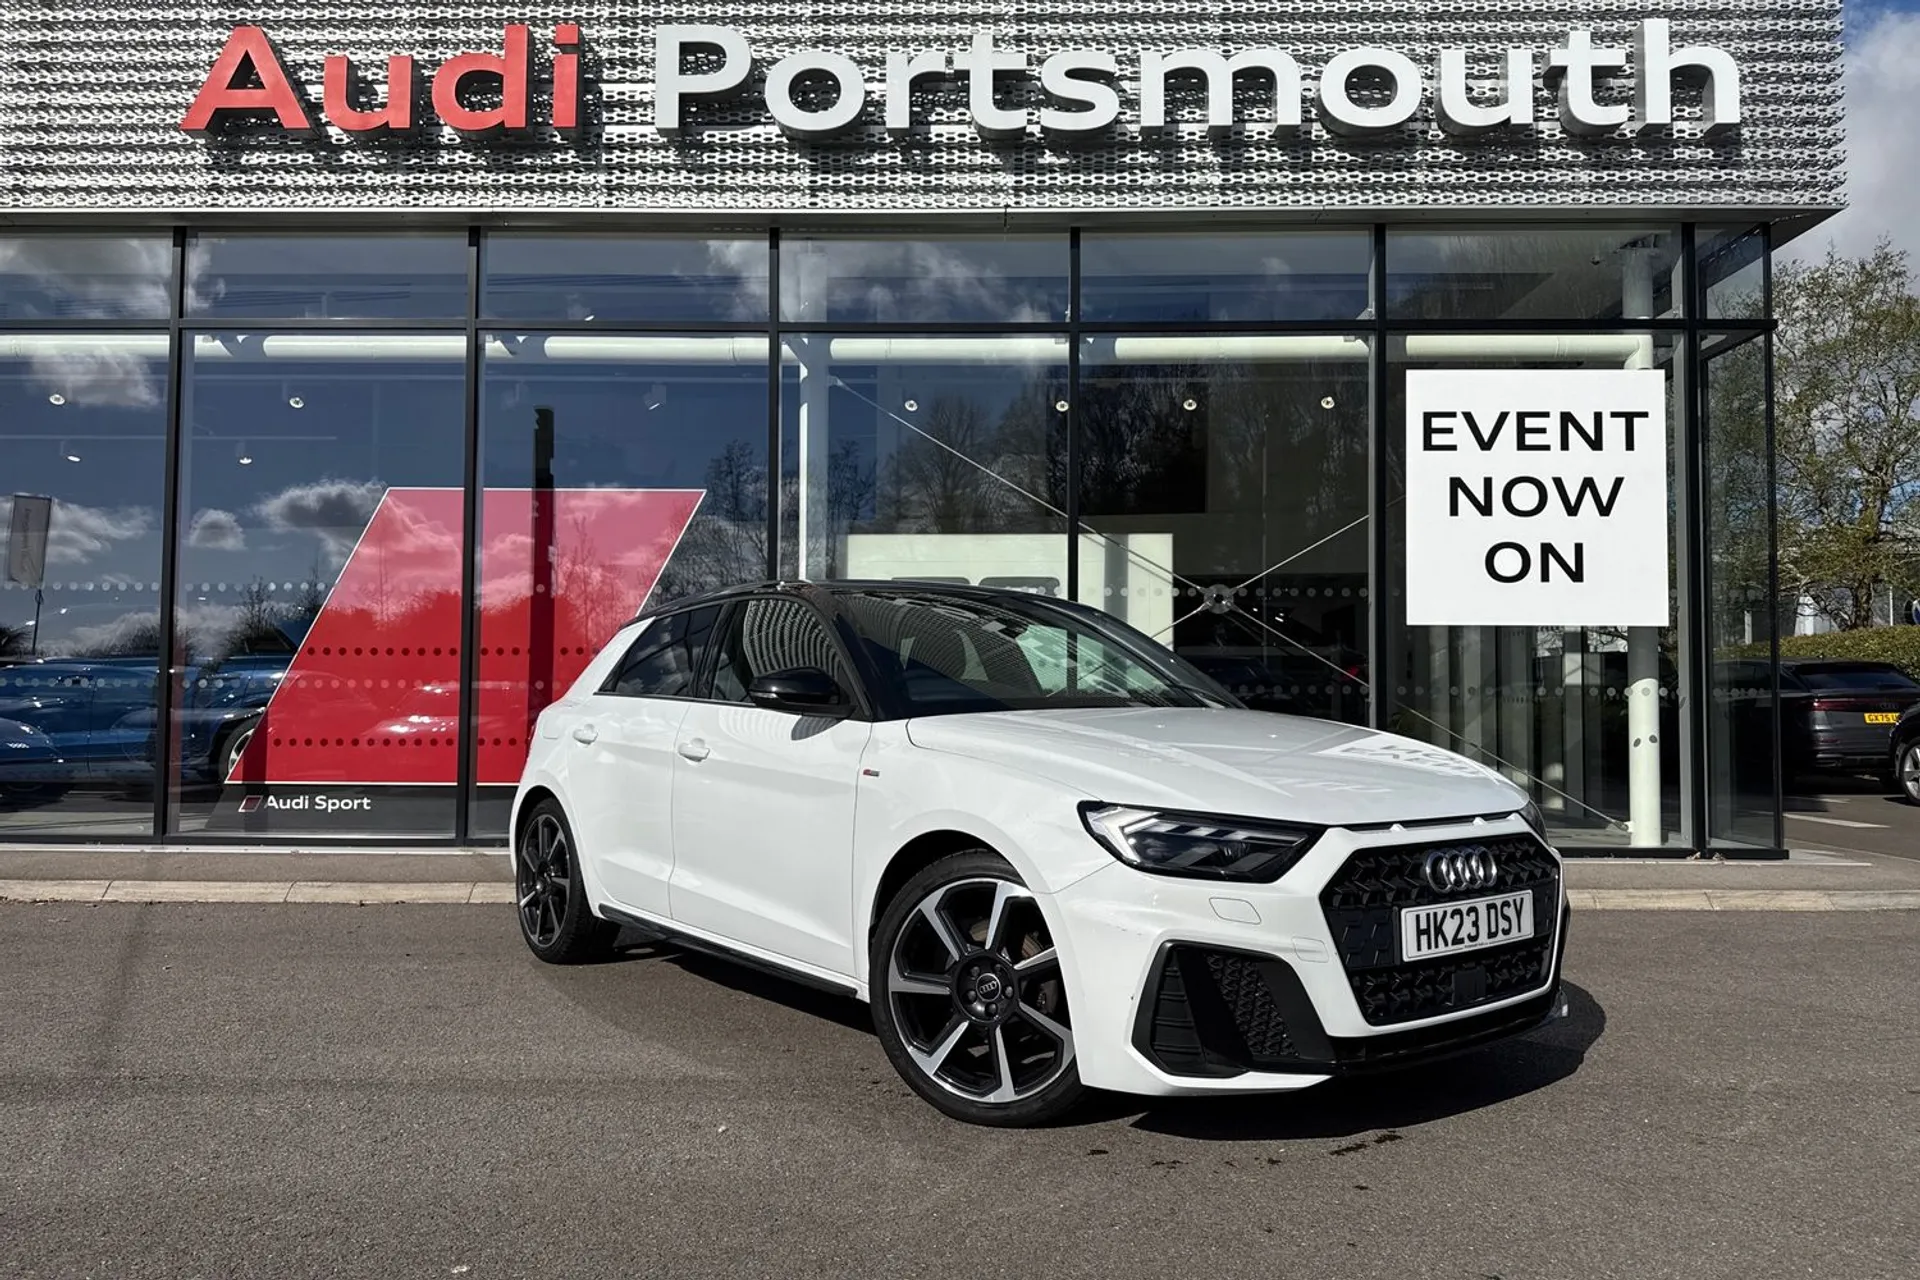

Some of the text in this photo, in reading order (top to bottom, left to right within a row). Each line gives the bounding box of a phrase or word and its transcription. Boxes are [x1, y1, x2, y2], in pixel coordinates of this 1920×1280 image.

[180, 18, 1741, 134] Audi Portsmouth
[1422, 411, 1649, 451] EVENT
[1449, 475, 1625, 517] NOW
[1484, 541, 1585, 583] ON
[264, 795, 371, 813] Audi Sport
[1415, 897, 1524, 952] HK23 DSY
